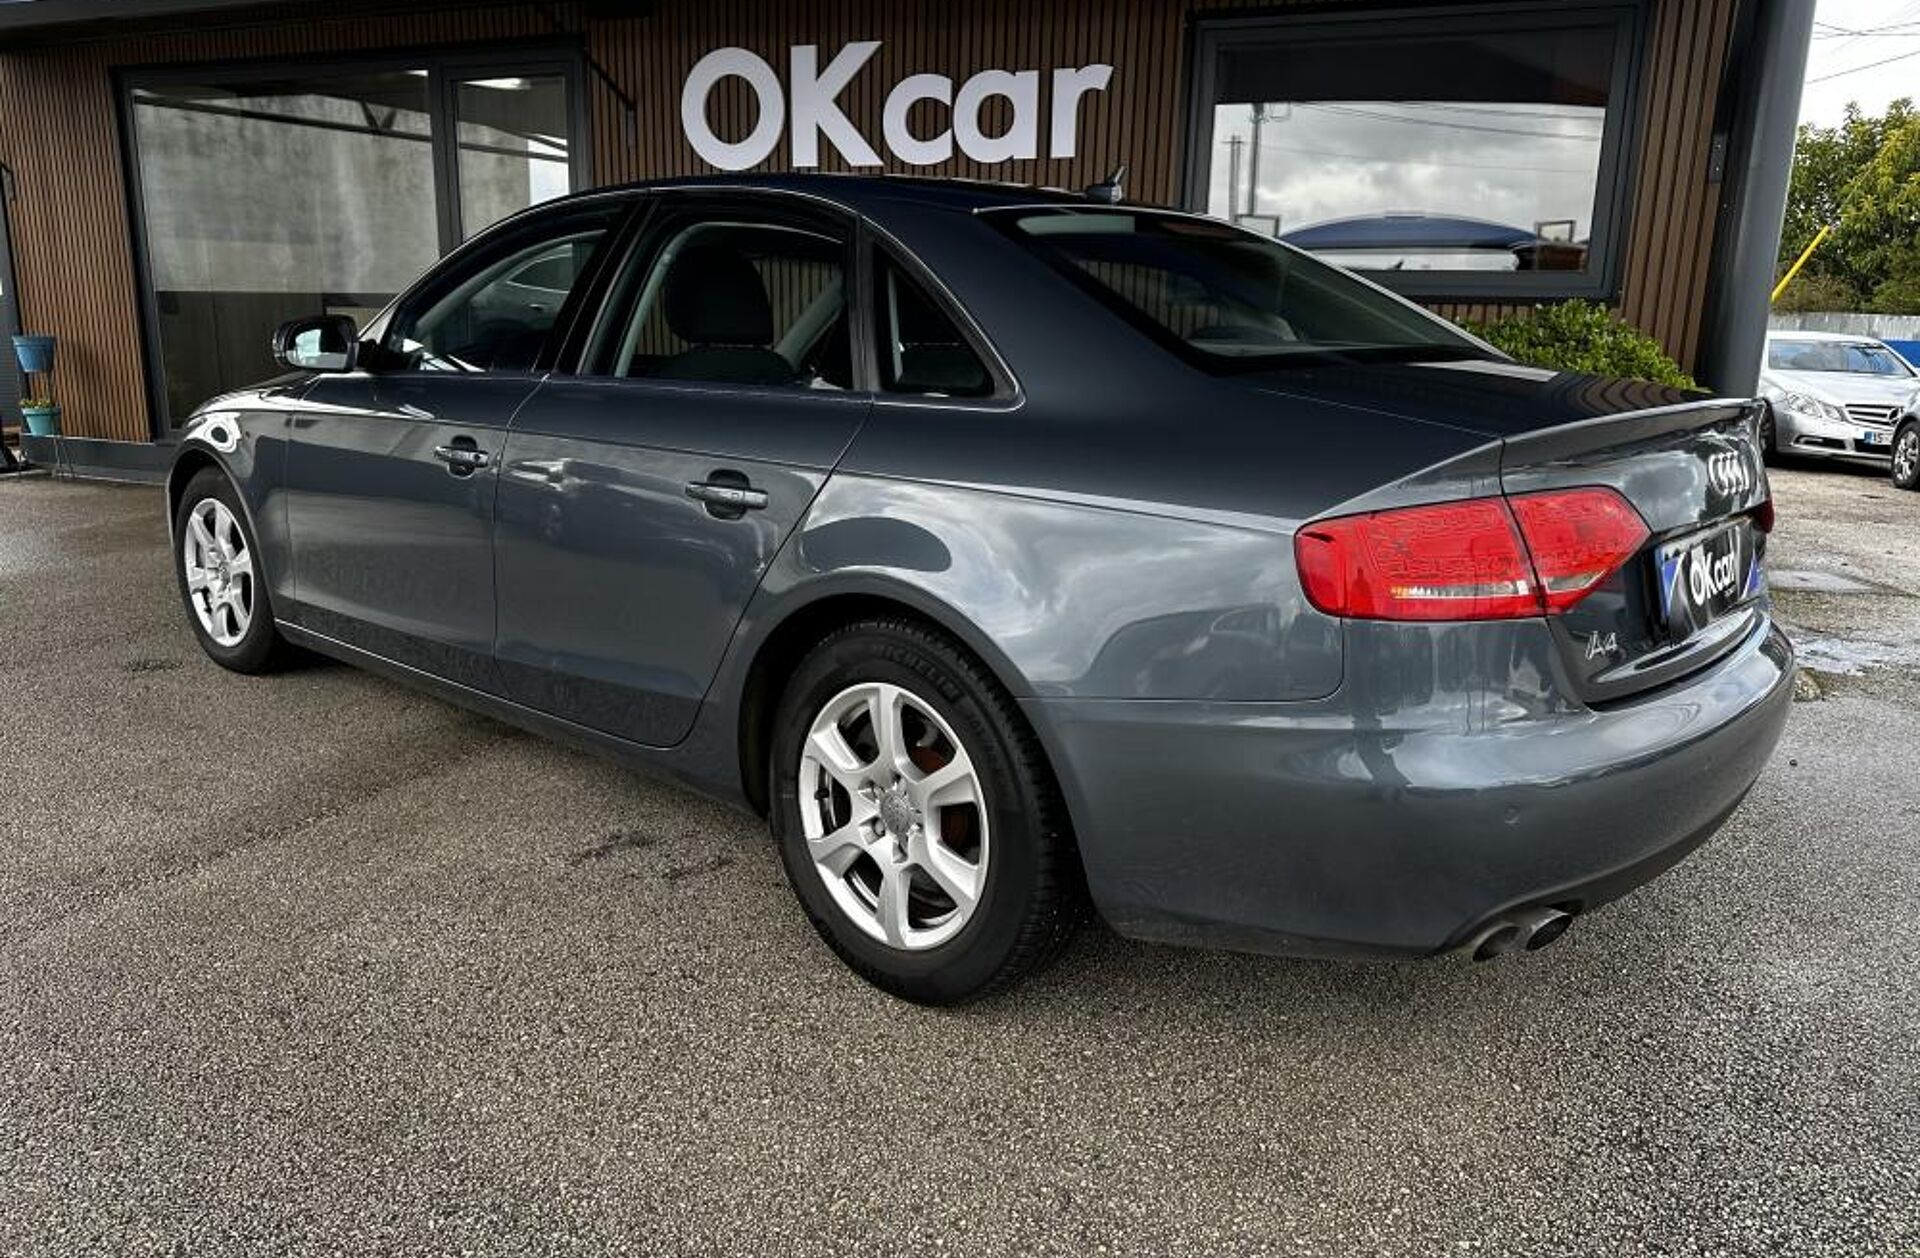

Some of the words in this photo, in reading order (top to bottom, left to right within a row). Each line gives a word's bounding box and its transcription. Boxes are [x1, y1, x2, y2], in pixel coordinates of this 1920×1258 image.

[681, 41, 1114, 171] OKcar
[1690, 551, 1735, 606] OKcar
[1585, 630, 1618, 660] A4
